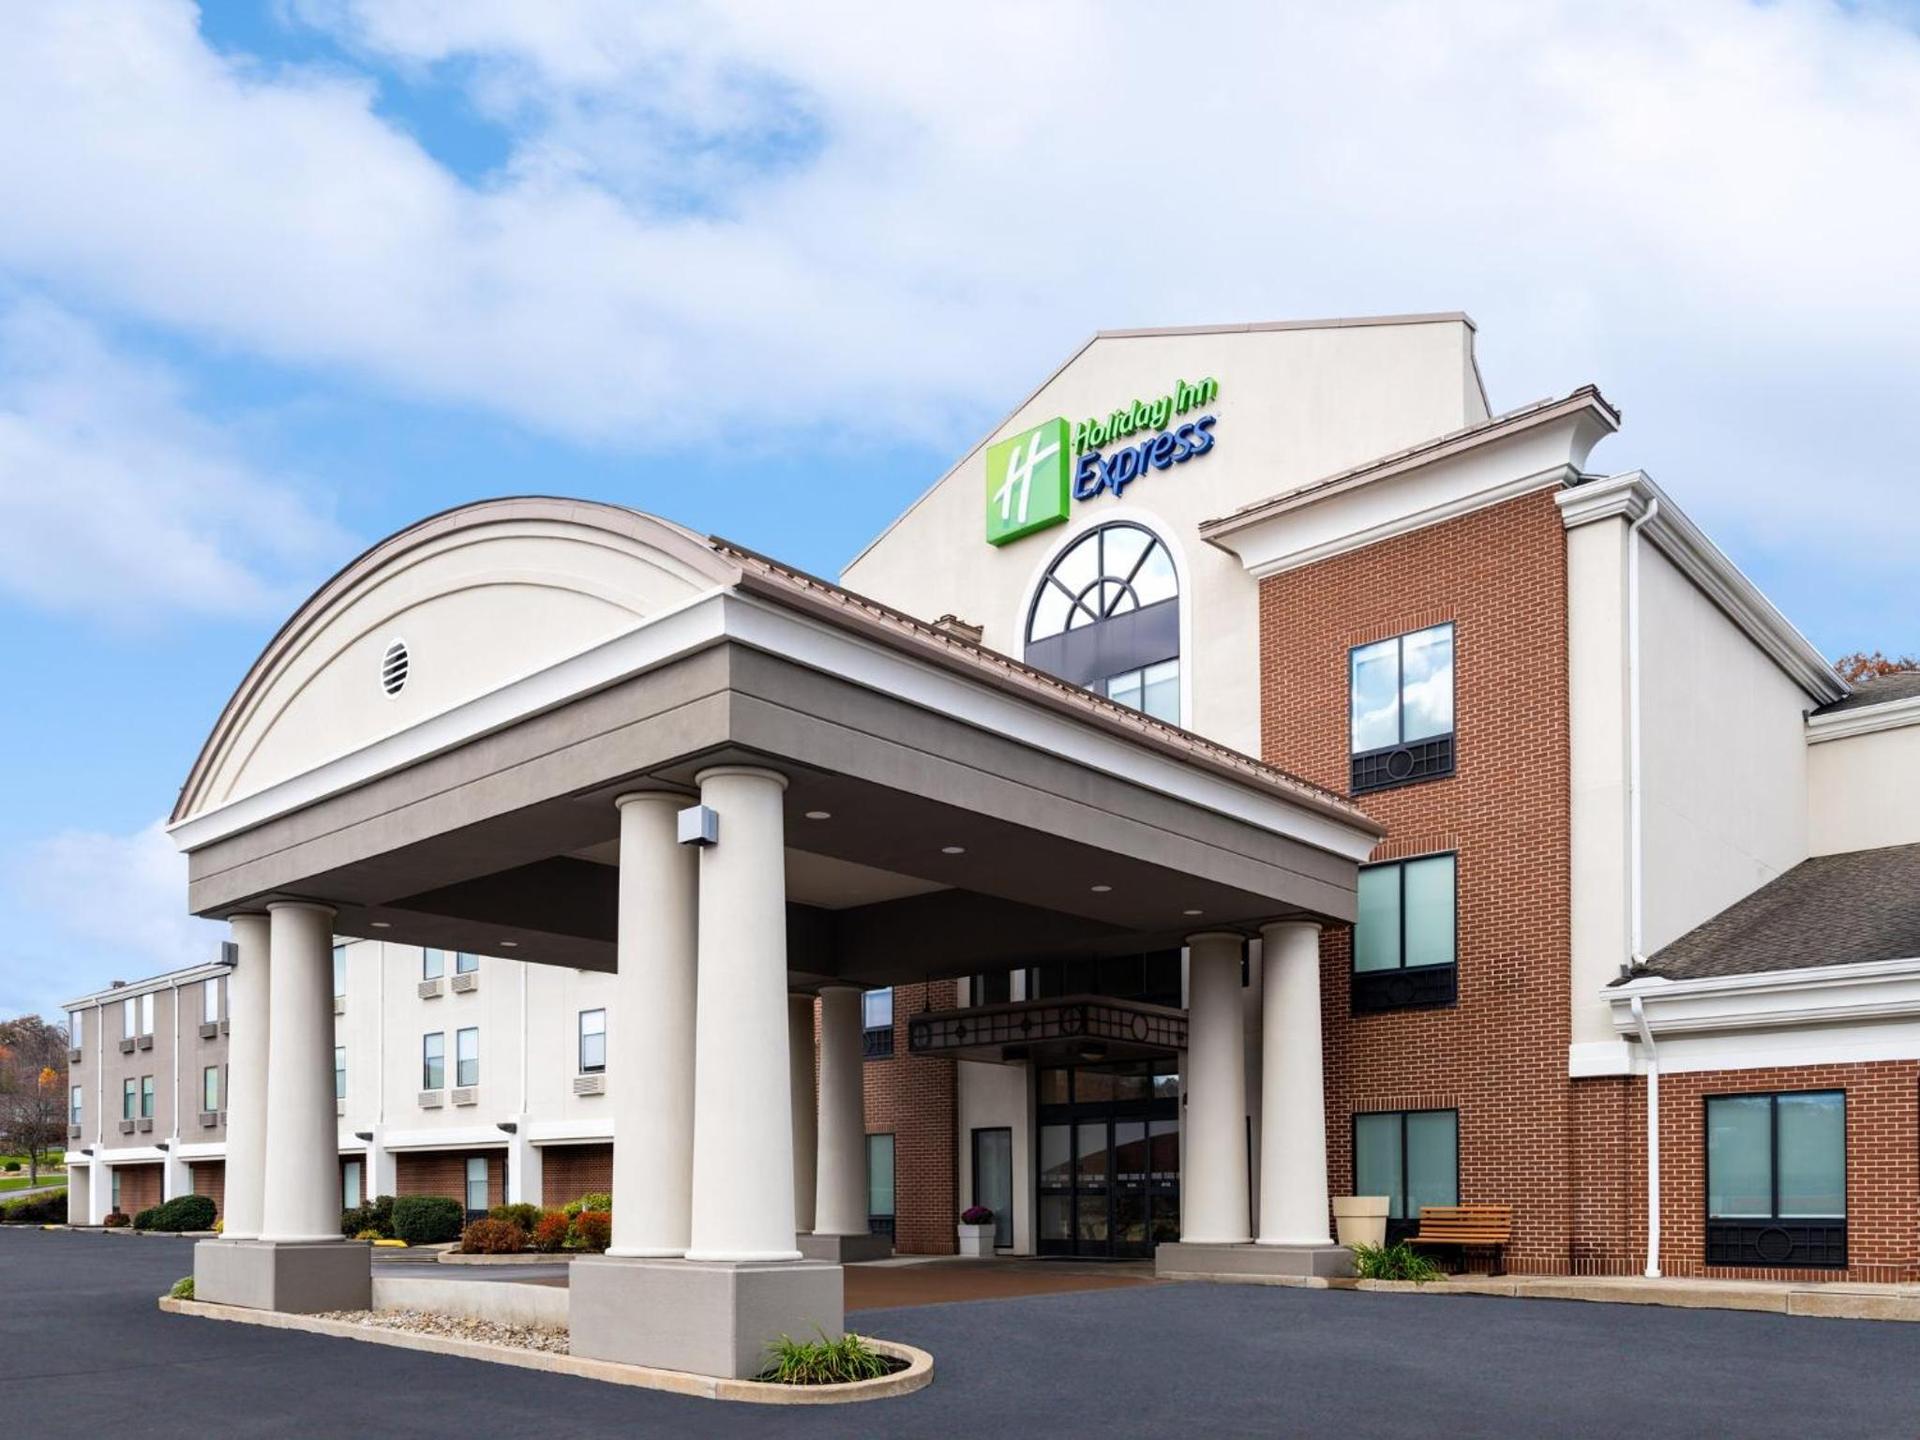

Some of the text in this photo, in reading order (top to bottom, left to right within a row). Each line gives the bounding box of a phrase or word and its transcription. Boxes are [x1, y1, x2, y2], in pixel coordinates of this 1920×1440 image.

[1073, 415, 1216, 501] Express
[1074, 377, 1218, 455] Holiday Inn
[994, 431, 1060, 523] H
